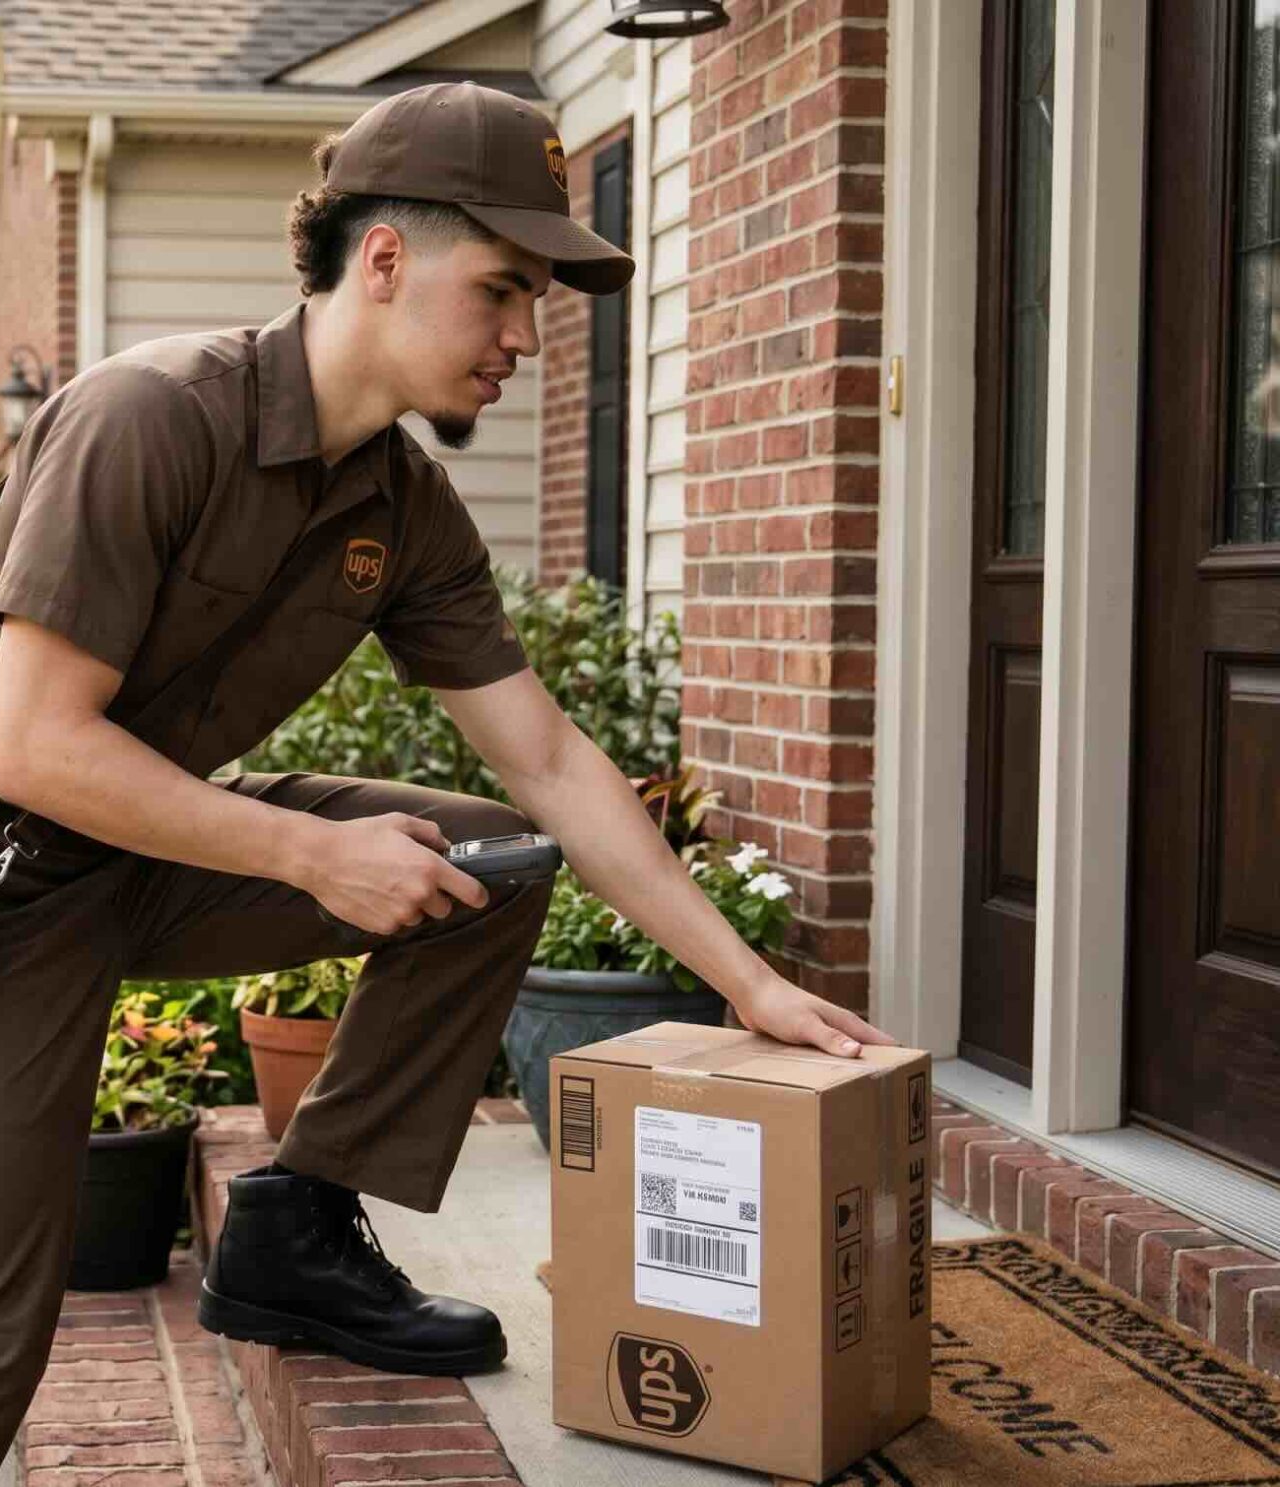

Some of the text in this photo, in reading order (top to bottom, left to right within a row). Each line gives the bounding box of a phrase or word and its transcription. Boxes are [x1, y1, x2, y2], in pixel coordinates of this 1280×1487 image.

[347, 553, 380, 581] ups
[909, 1158, 925, 1319] FRAGILE
[640, 1346, 691, 1426] ups
